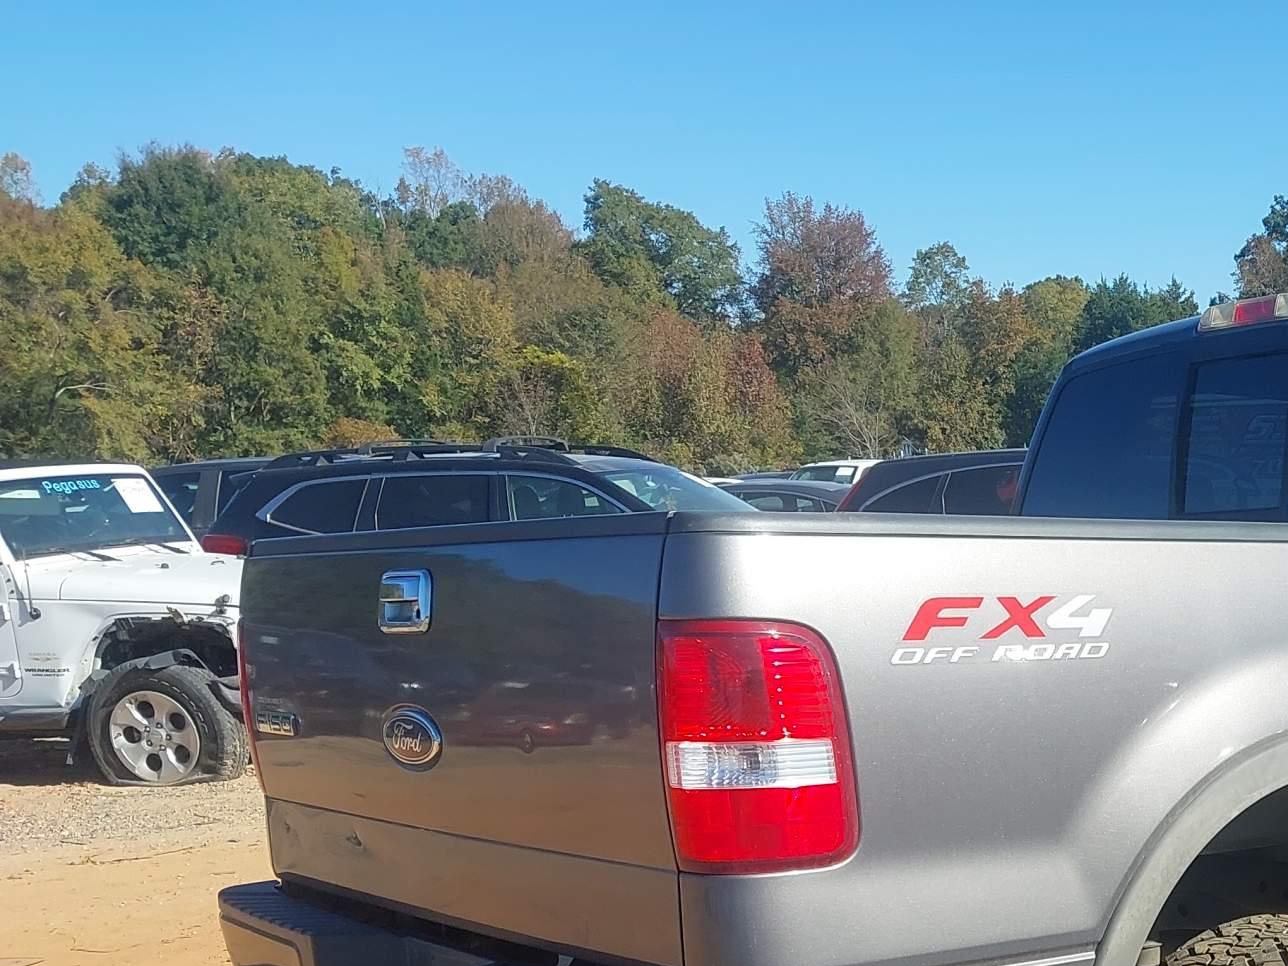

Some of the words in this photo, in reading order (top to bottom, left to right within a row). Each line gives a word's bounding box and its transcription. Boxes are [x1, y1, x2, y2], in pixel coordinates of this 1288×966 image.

[42, 479, 101, 494] Pegasus
[901, 594, 1113, 643] FX4
[890, 645, 982, 667] OFF
[991, 641, 1111, 664] ROAD
[391, 720, 423, 753] Ford
